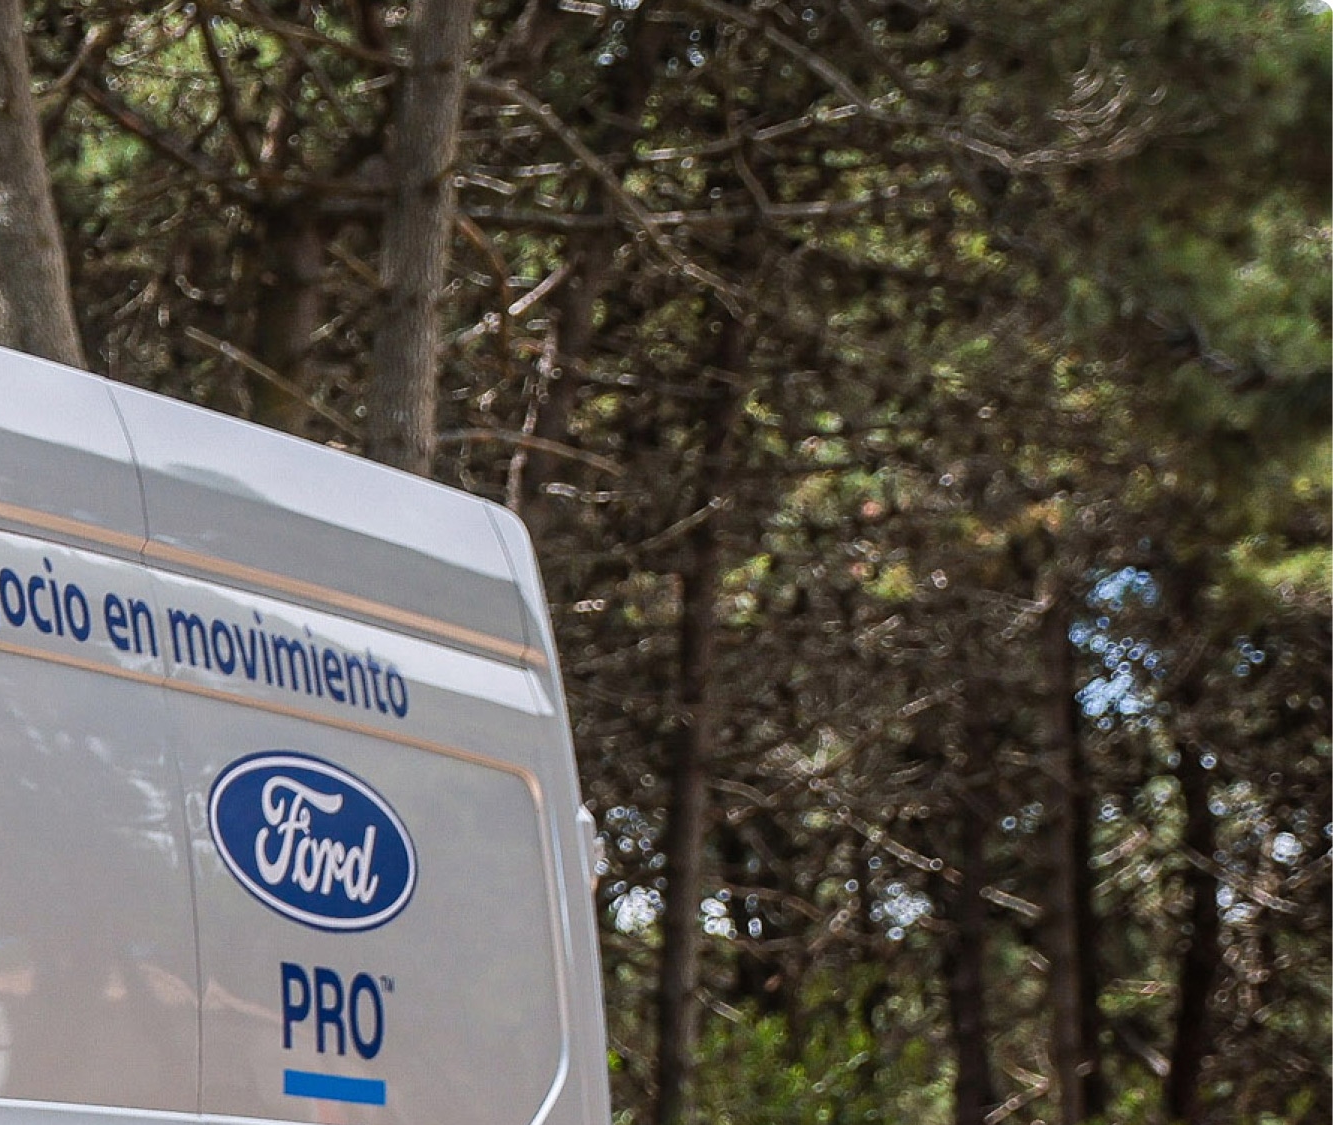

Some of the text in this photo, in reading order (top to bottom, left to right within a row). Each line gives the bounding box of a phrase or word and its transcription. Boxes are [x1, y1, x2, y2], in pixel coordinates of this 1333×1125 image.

[104, 593, 158, 657] en
[167, 608, 409, 718] movimiento
[255, 776, 379, 904] Ford
[280, 961, 385, 1060] PRO
